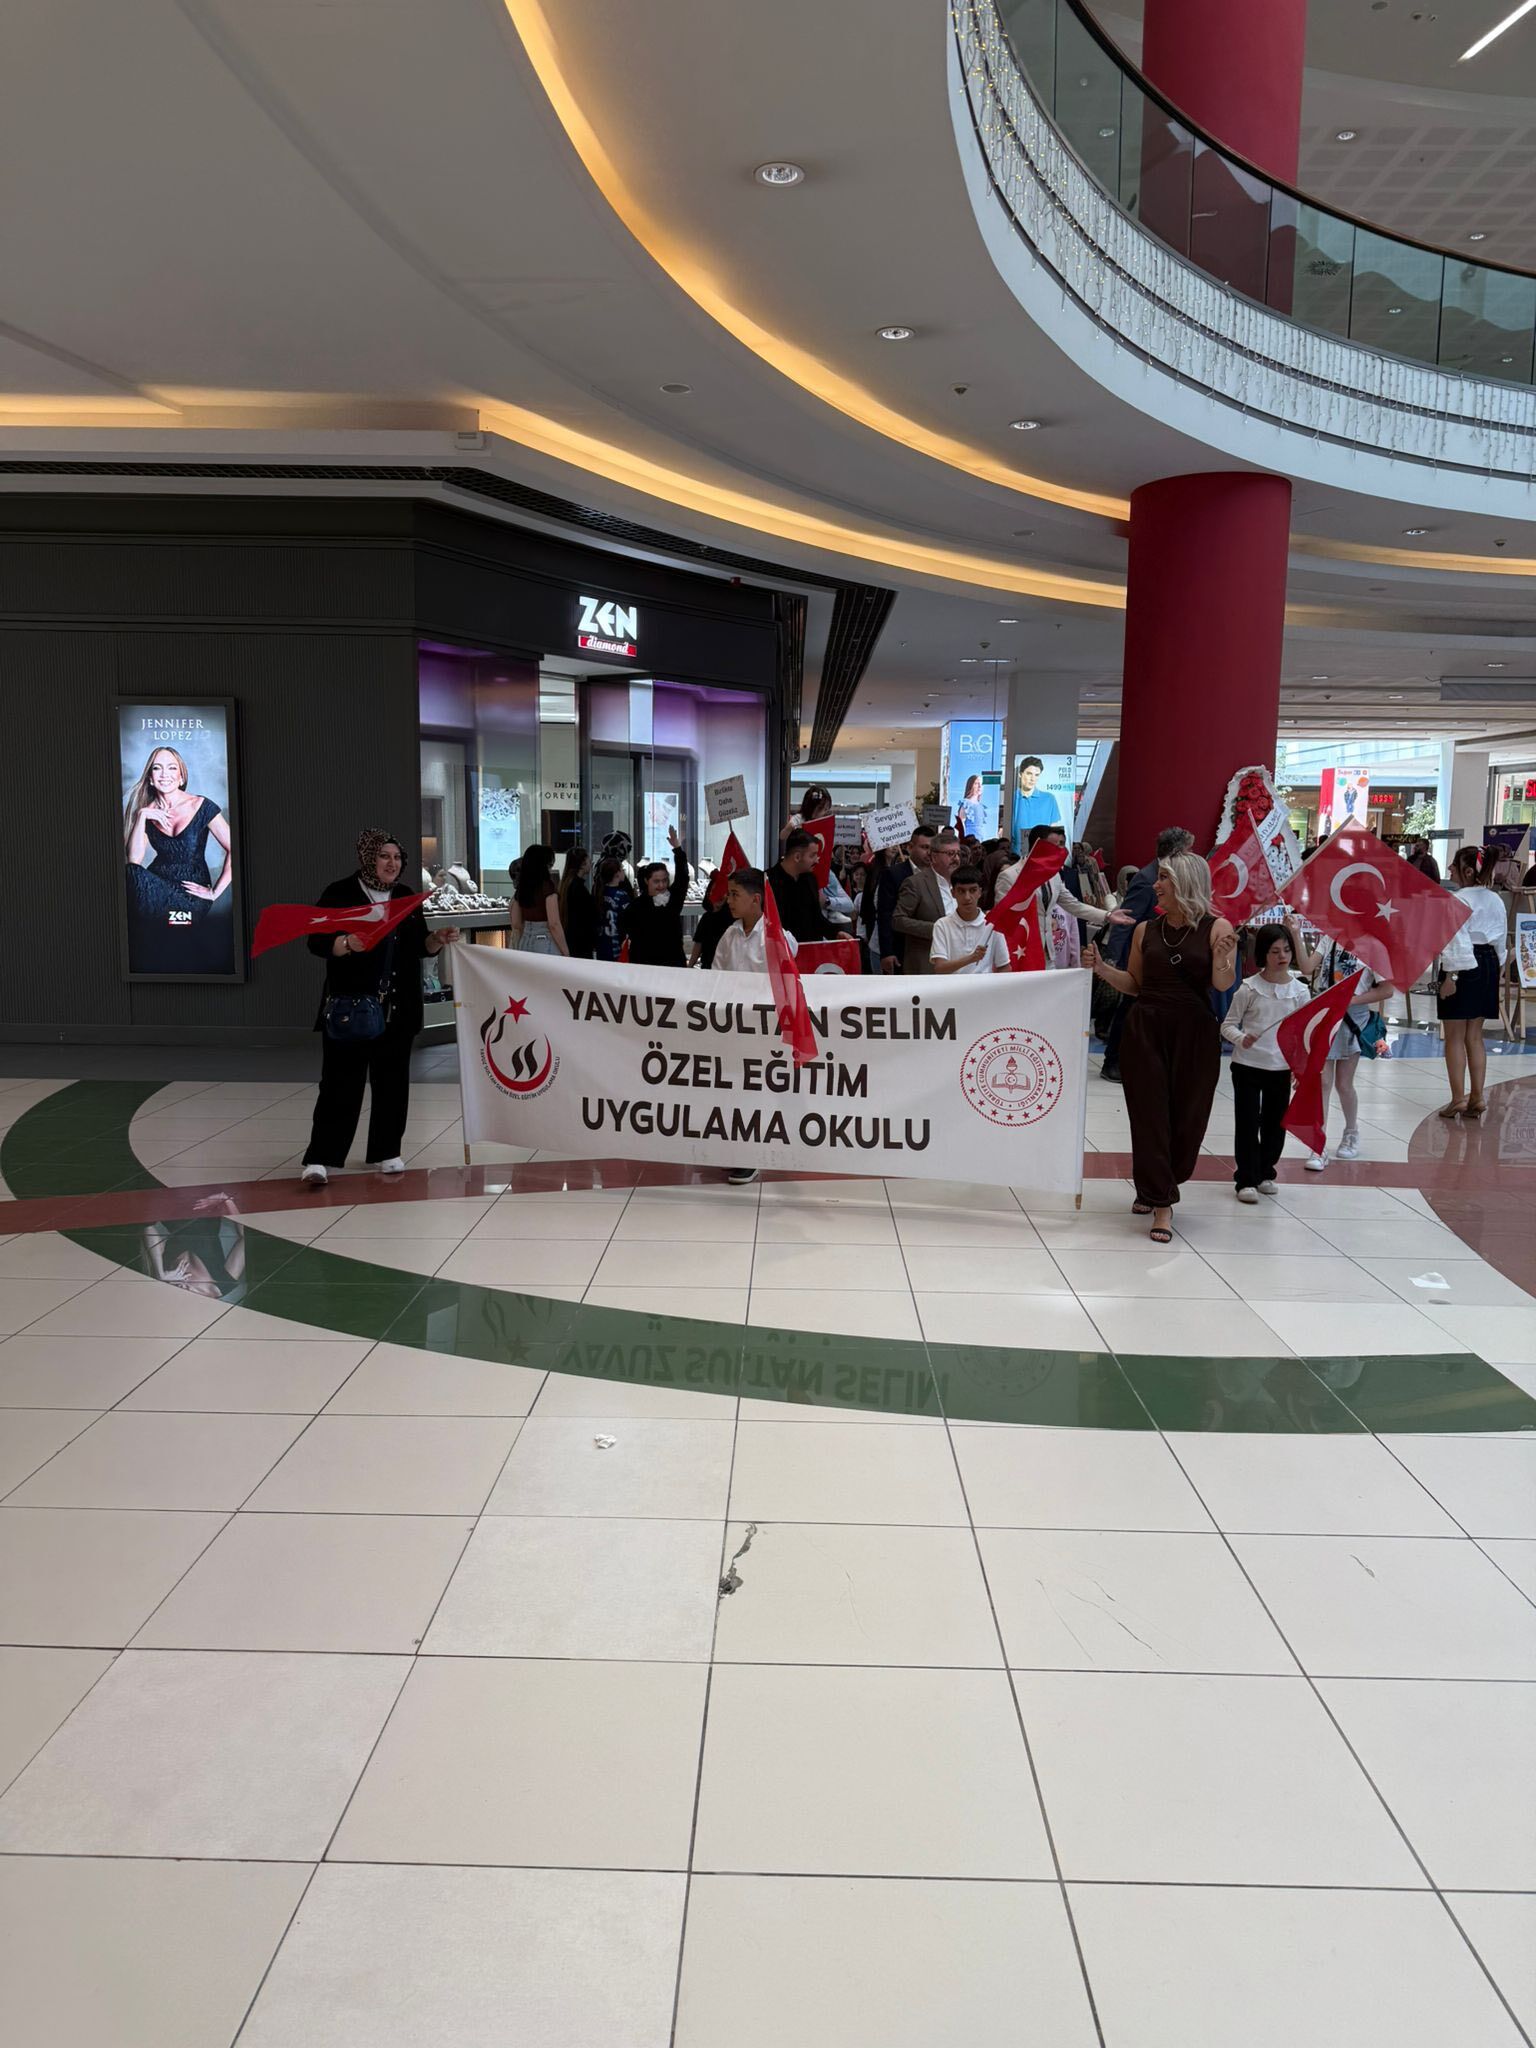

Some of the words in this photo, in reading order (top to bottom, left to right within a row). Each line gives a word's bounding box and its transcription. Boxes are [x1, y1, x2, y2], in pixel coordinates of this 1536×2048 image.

[578, 595, 637, 641] ZEN
[586, 635, 629, 653] diamond
[141, 718, 204, 730] JENNIFER
[153, 730, 193, 741] LOPEZ
[960, 734, 992, 754] B&G
[1066, 756, 1072, 766] 3
[874, 810, 904, 824] Sevgiyle
[878, 819, 907, 833] Engelsiz
[168, 910, 192, 921] ZEN
[561, 988, 678, 1029] YAVUZ
[686, 1000, 829, 1038] SULTAN
[840, 995, 957, 1041] SELİM
[641, 1040, 733, 1089] ÖZEL
[743, 1050, 868, 1098] EĞİTİM
[978, 1046, 1009, 1083] CUMHURİYETİ
[1009, 1045, 1030, 1055] MİLLİ
[582, 1096, 791, 1145] UYGULAMA
[799, 1112, 930, 1151] OKULU
